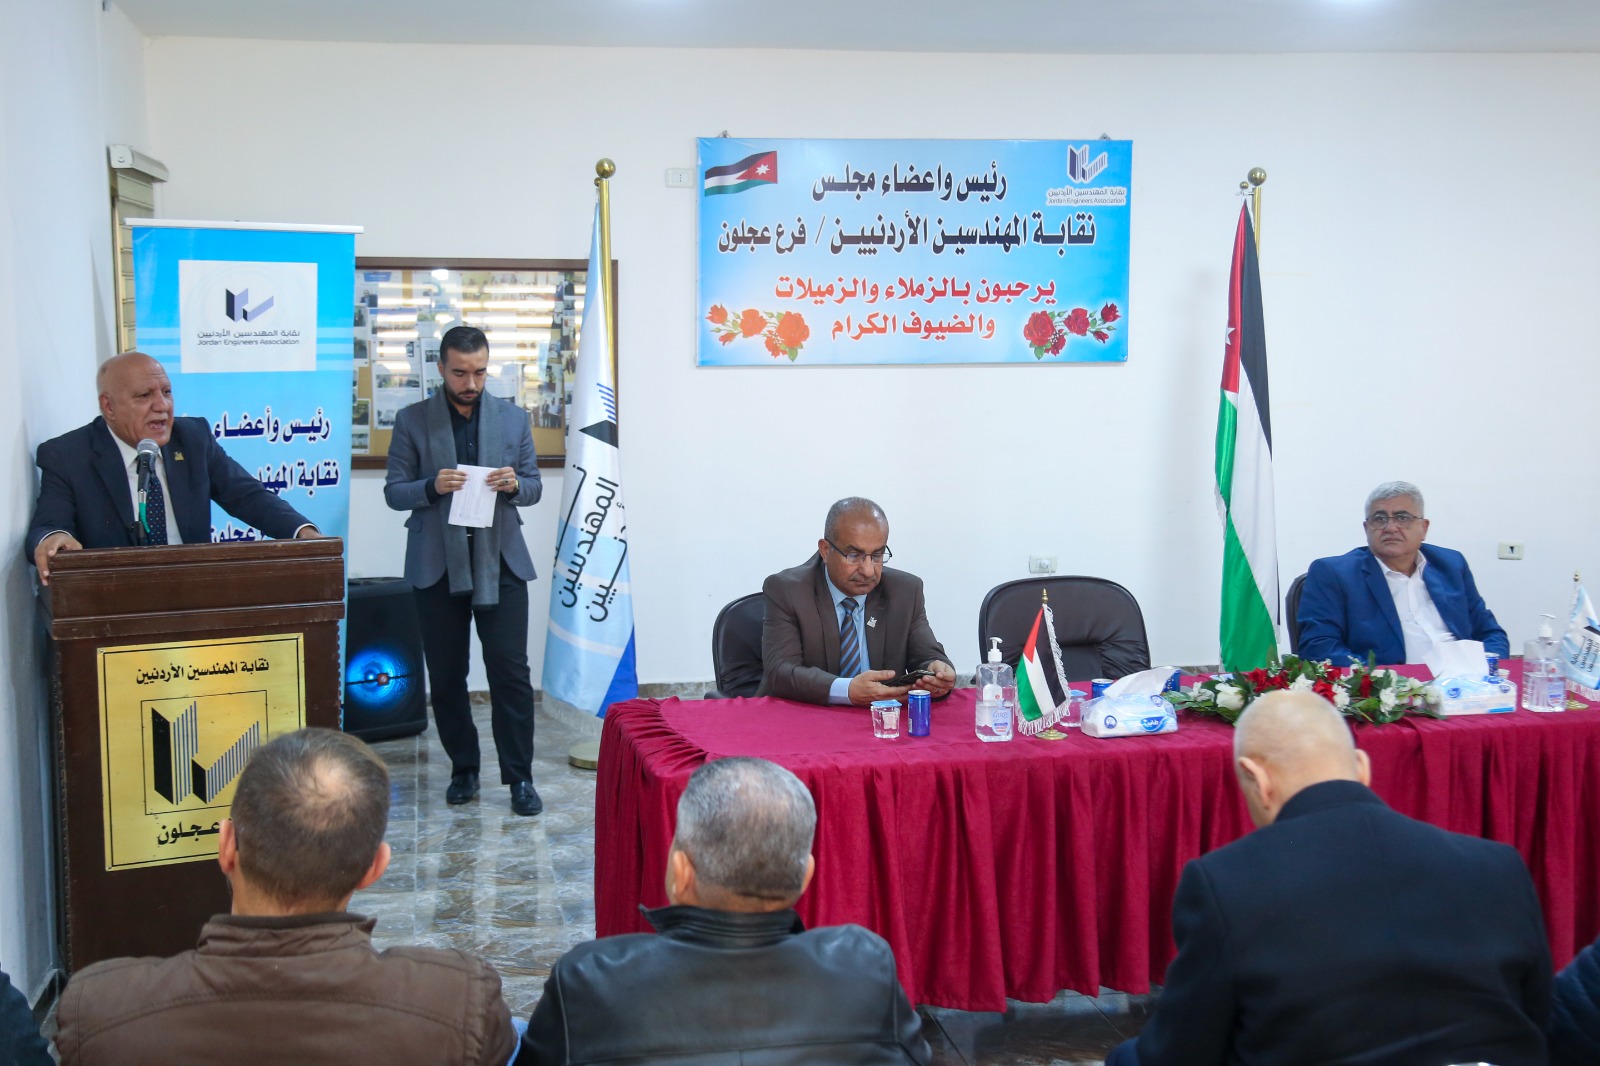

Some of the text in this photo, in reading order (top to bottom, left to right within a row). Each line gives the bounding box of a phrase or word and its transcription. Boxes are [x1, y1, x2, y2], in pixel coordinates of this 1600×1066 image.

[812, 161, 1007, 202] رئيس واعضاء مجلس
[718, 220, 772, 253] عجلون
[776, 217, 806, 254] فرع
[830, 209, 928, 255] الأردنيين
[933, 213, 1027, 255] المهندسين
[1032, 212, 1096, 256] نقابة
[775, 276, 1057, 305] يرحبون بالزملاء والزميلات
[233, 329, 278, 338] المهندسين
[280, 329, 300, 338] نقابة
[832, 311, 995, 341] والضيوف الكرام
[223, 339, 258, 347] Engineers
[213, 407, 330, 442] رئيس وأعضاء
[259, 461, 339, 496] نقابة المهند
[187, 660, 238, 681] المهندسين
[240, 658, 270, 675] نقابة
